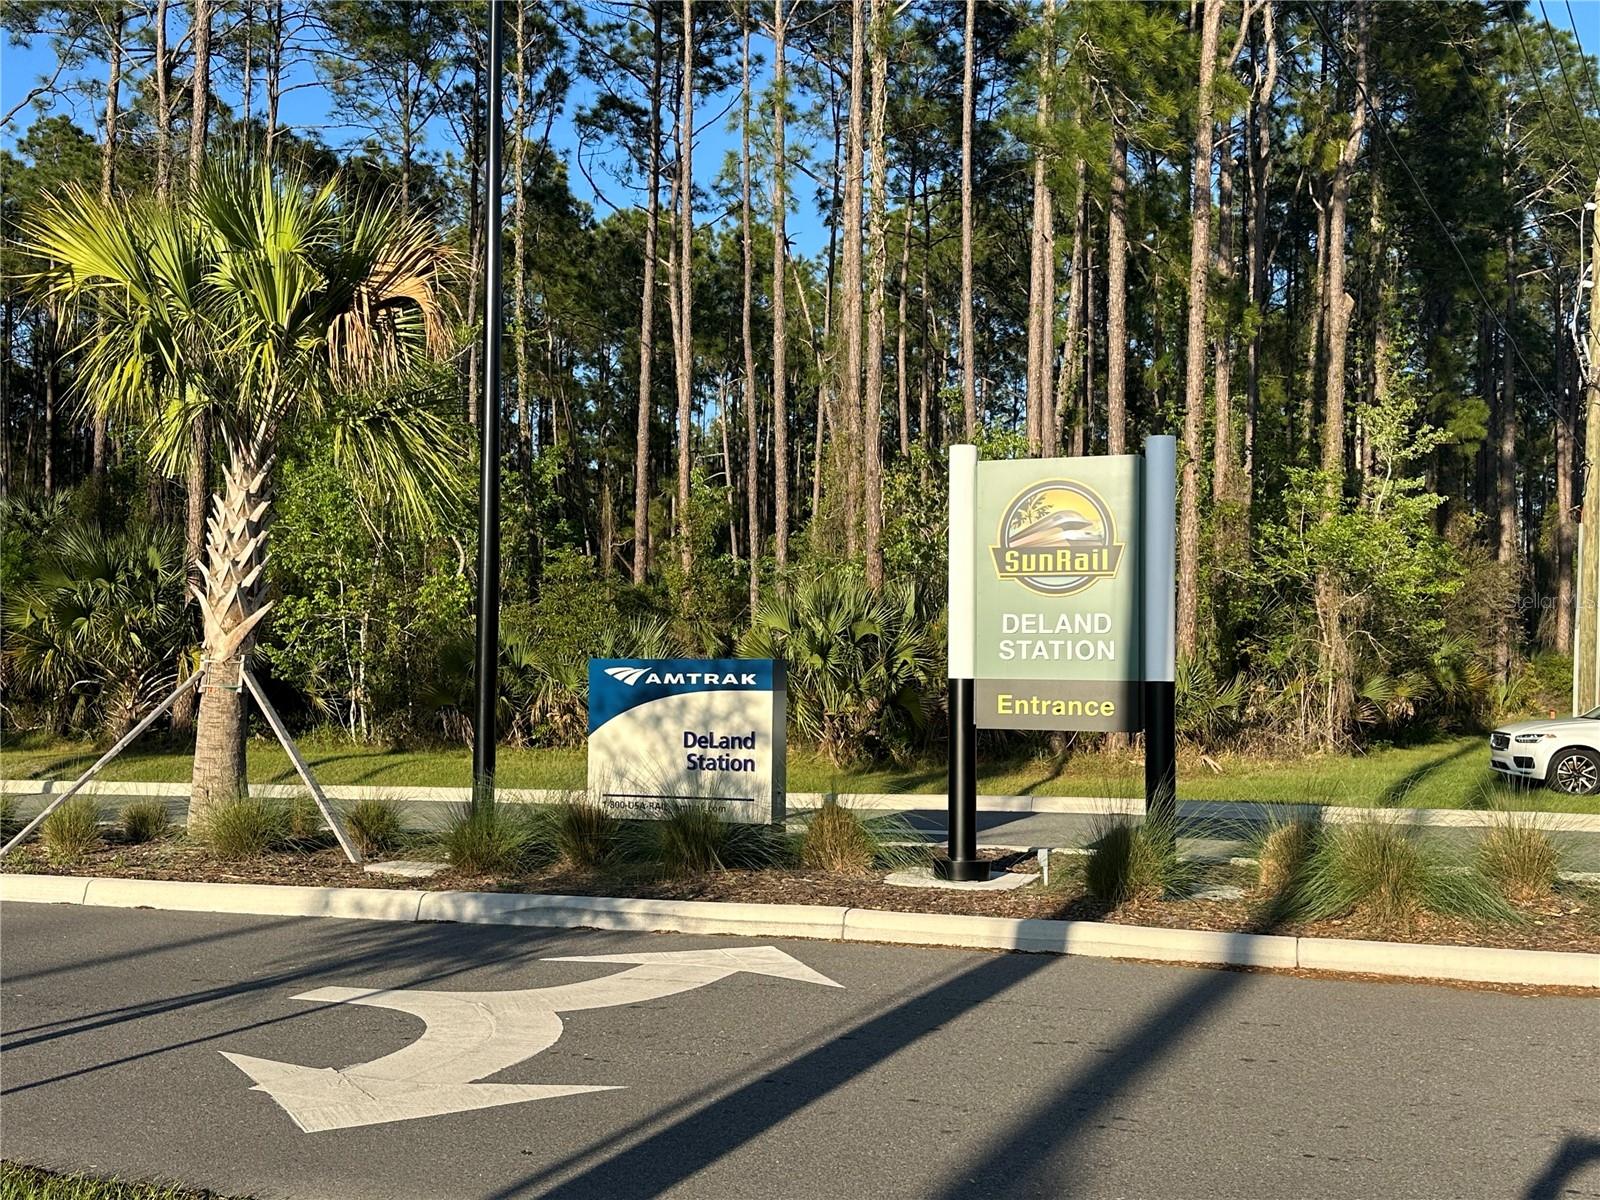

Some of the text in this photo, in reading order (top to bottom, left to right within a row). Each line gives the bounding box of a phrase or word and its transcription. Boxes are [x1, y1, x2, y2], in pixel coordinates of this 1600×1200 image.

[1005, 549, 1109, 573] SunRail
[1002, 613, 1112, 634] DELAND
[999, 640, 1116, 661] STATION
[645, 673, 757, 685] AMTRAK
[997, 694, 1115, 717] Entrance
[683, 731, 756, 750] DeLand
[686, 753, 756, 772] Station
